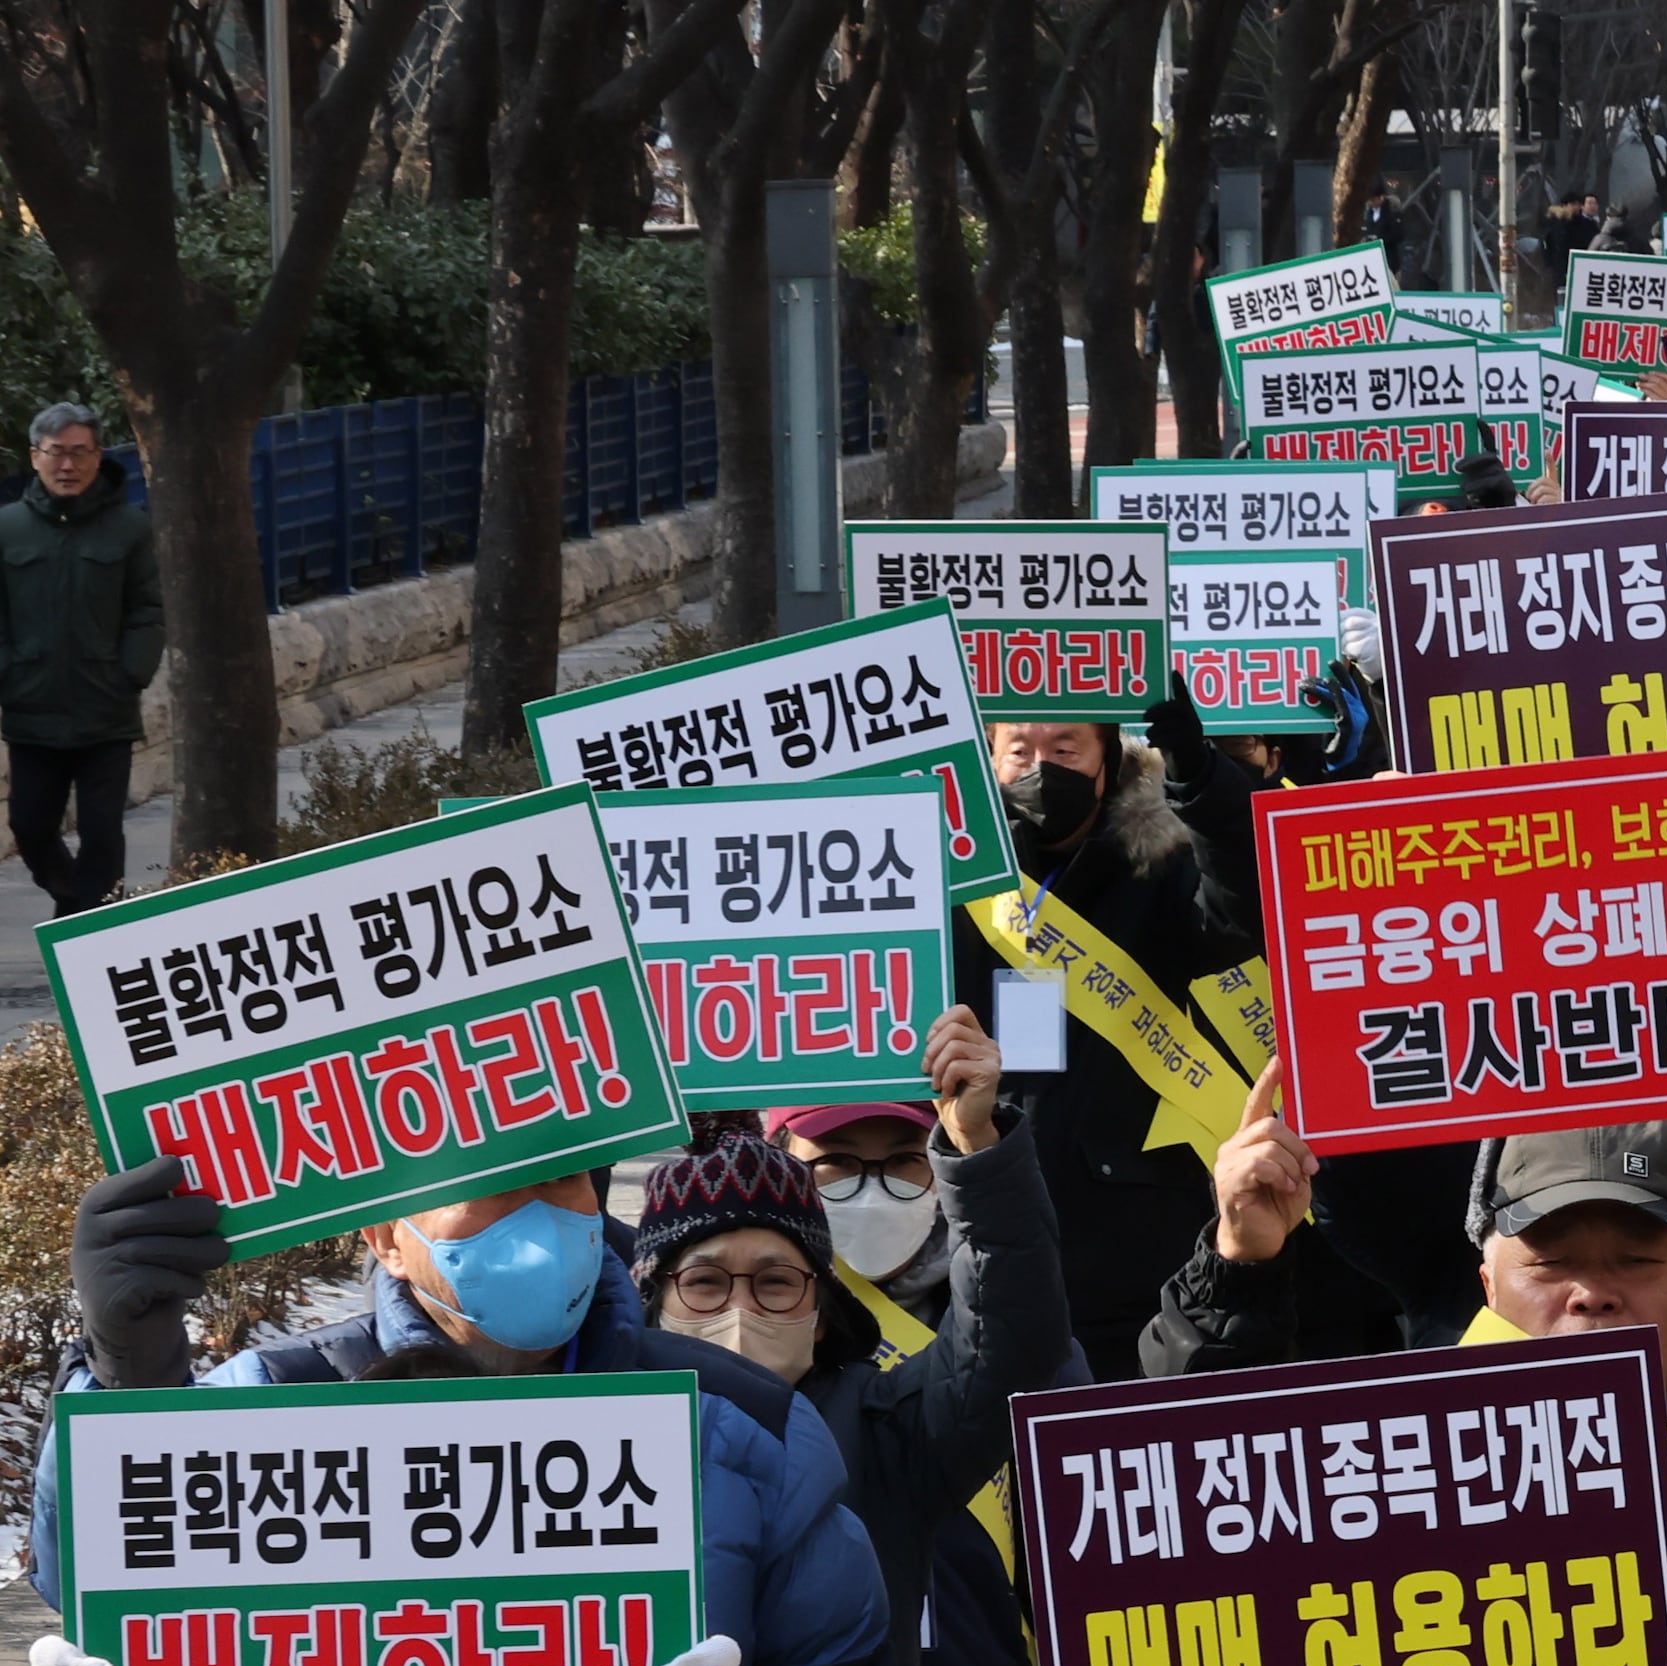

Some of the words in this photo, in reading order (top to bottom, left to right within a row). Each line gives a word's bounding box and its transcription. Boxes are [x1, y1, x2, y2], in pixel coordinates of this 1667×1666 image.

[1227, 287, 1300, 330] 불확정적
[1306, 266, 1380, 312] 평가요소
[1586, 271, 1666, 312] 불확정적
[1261, 371, 1358, 417] 불확정적
[1369, 365, 1465, 410] 평가요소
[1241, 492, 1351, 540] 평가요소
[877, 553, 1003, 610] 불확정적
[1020, 554, 1147, 610] 평가요소
[1204, 581, 1321, 629] 평가요소
[715, 828, 916, 922] 평가요소
[1300, 810, 1593, 893] 피해주주권리,
[108, 913, 345, 1066] 불확정적
[359, 854, 592, 1001] 평가요소
[1303, 897, 1502, 992] 금융위
[144, 986, 631, 1208] 배제하라!
[118, 1446, 371, 1570] 불확정적
[402, 1438, 659, 1560] 평가요소
[1061, 1439, 1185, 1566] 거래
